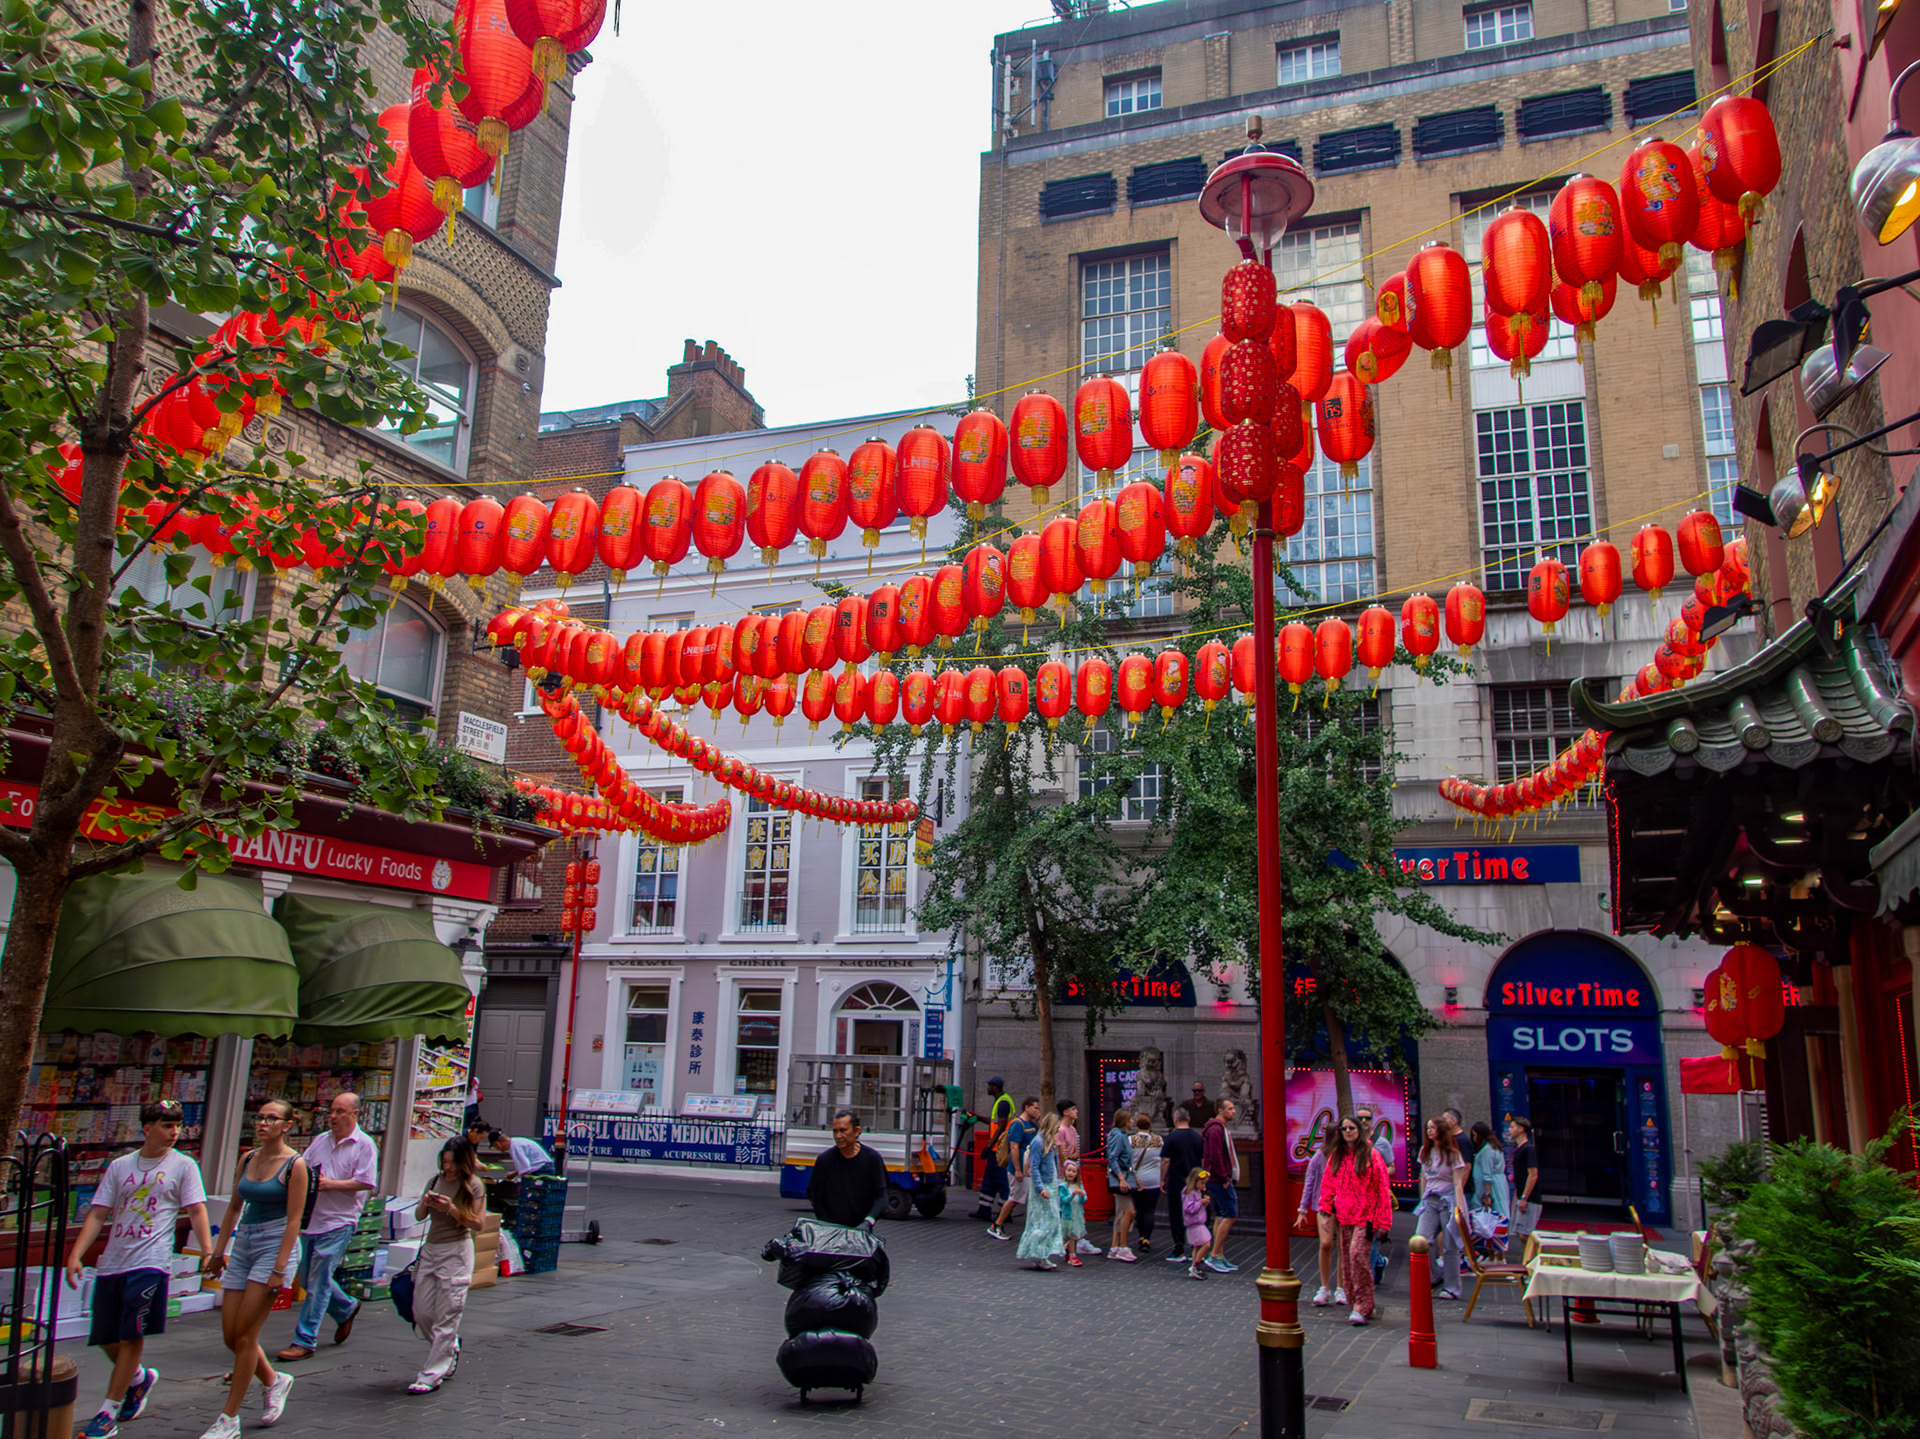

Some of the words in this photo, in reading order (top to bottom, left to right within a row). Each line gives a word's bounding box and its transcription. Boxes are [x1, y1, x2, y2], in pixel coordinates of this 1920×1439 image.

[462, 725, 484, 739] STREET
[463, 715, 505, 735] MACCLESFIELD
[222, 827, 324, 869] IANFU
[326, 847, 374, 875] Lucky
[380, 856, 422, 881] Foods
[860, 841, 907, 866] 买房
[1390, 849, 1530, 881] verTime
[839, 959, 913, 967] MEDICINE
[1501, 981, 1641, 1007] SilverTime
[688, 1010, 705, 1075] 康泰診所
[1512, 1026, 1634, 1053] SLOTS
[1105, 1072, 1117, 1083] BE
[543, 1118, 610, 1140] EVRWELL
[613, 1121, 667, 1143] CHINESE
[670, 1123, 735, 1146] MEDICINE
[735, 1128, 767, 1146] 康泰
[622, 1147, 651, 1158] HERBS
[662, 1149, 727, 1162] ACUPRESSURE
[735, 1146, 766, 1164] 診所
